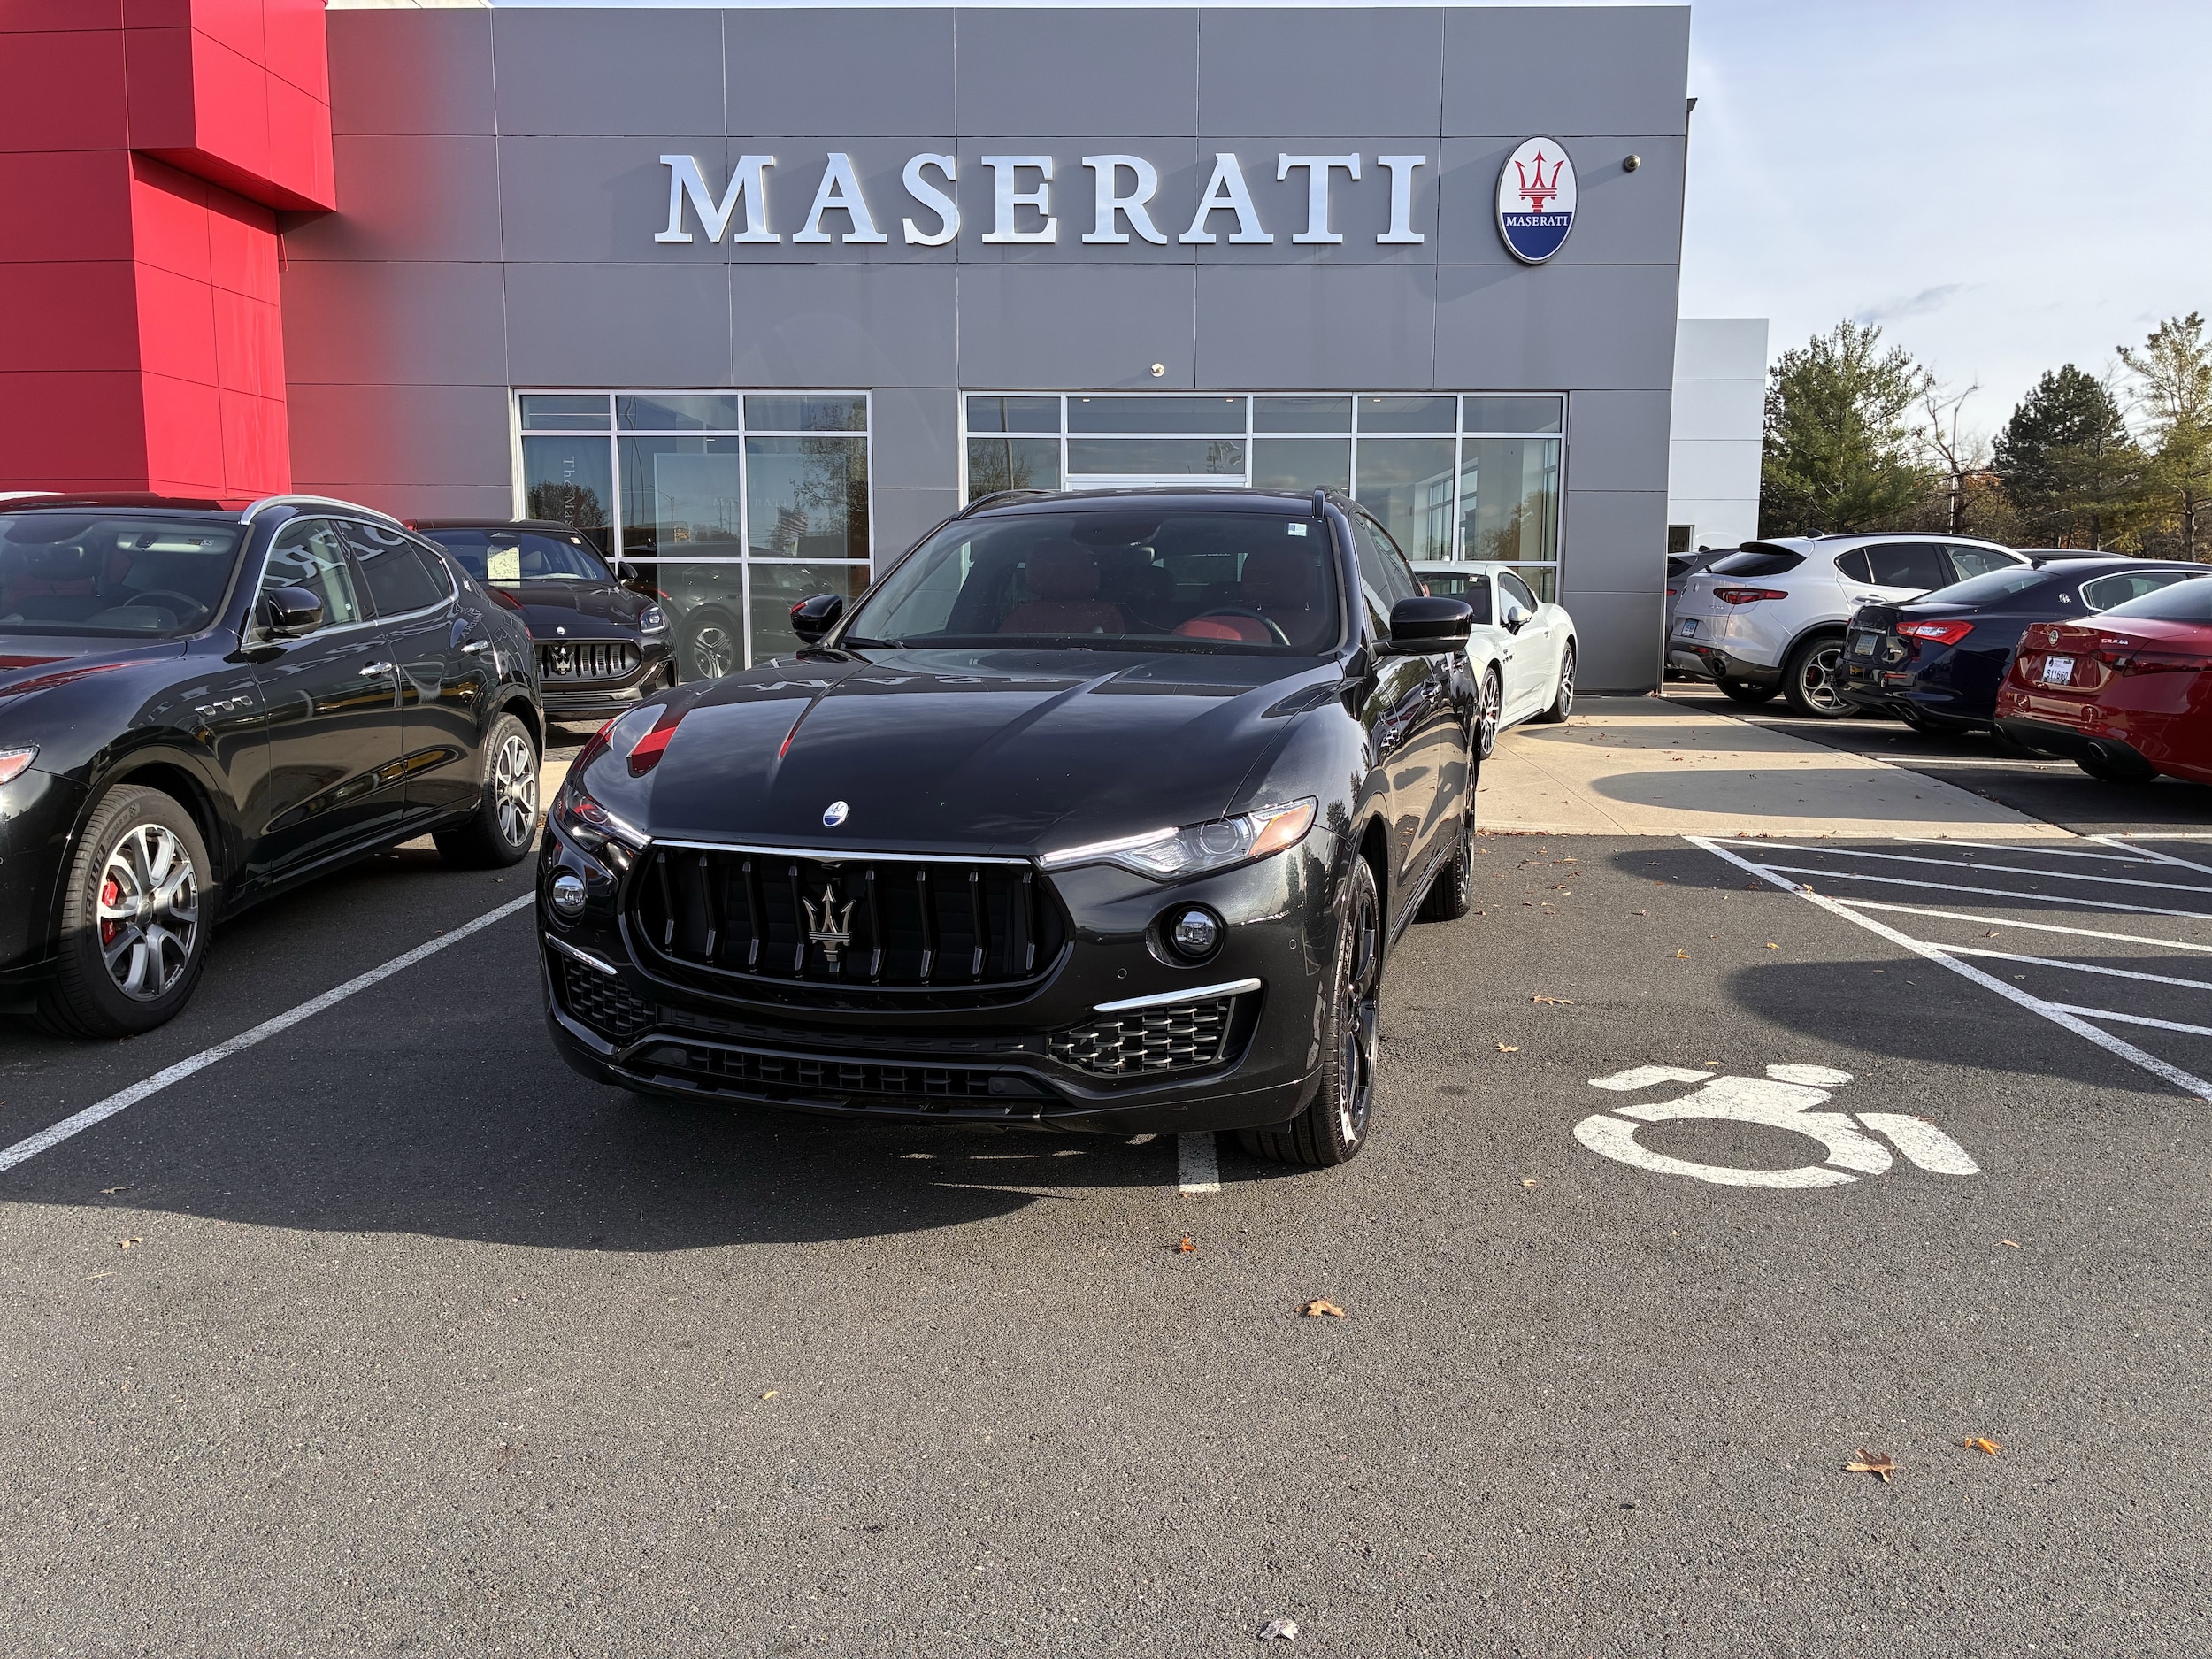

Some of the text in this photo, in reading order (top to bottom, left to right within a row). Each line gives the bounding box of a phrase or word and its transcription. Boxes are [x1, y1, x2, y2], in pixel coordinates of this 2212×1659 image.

[654, 152, 1425, 246] MASERATI
[1505, 216, 1569, 227] MASERATI
[563, 456, 575, 488] The
[2046, 669, 2069, 680] S11660
